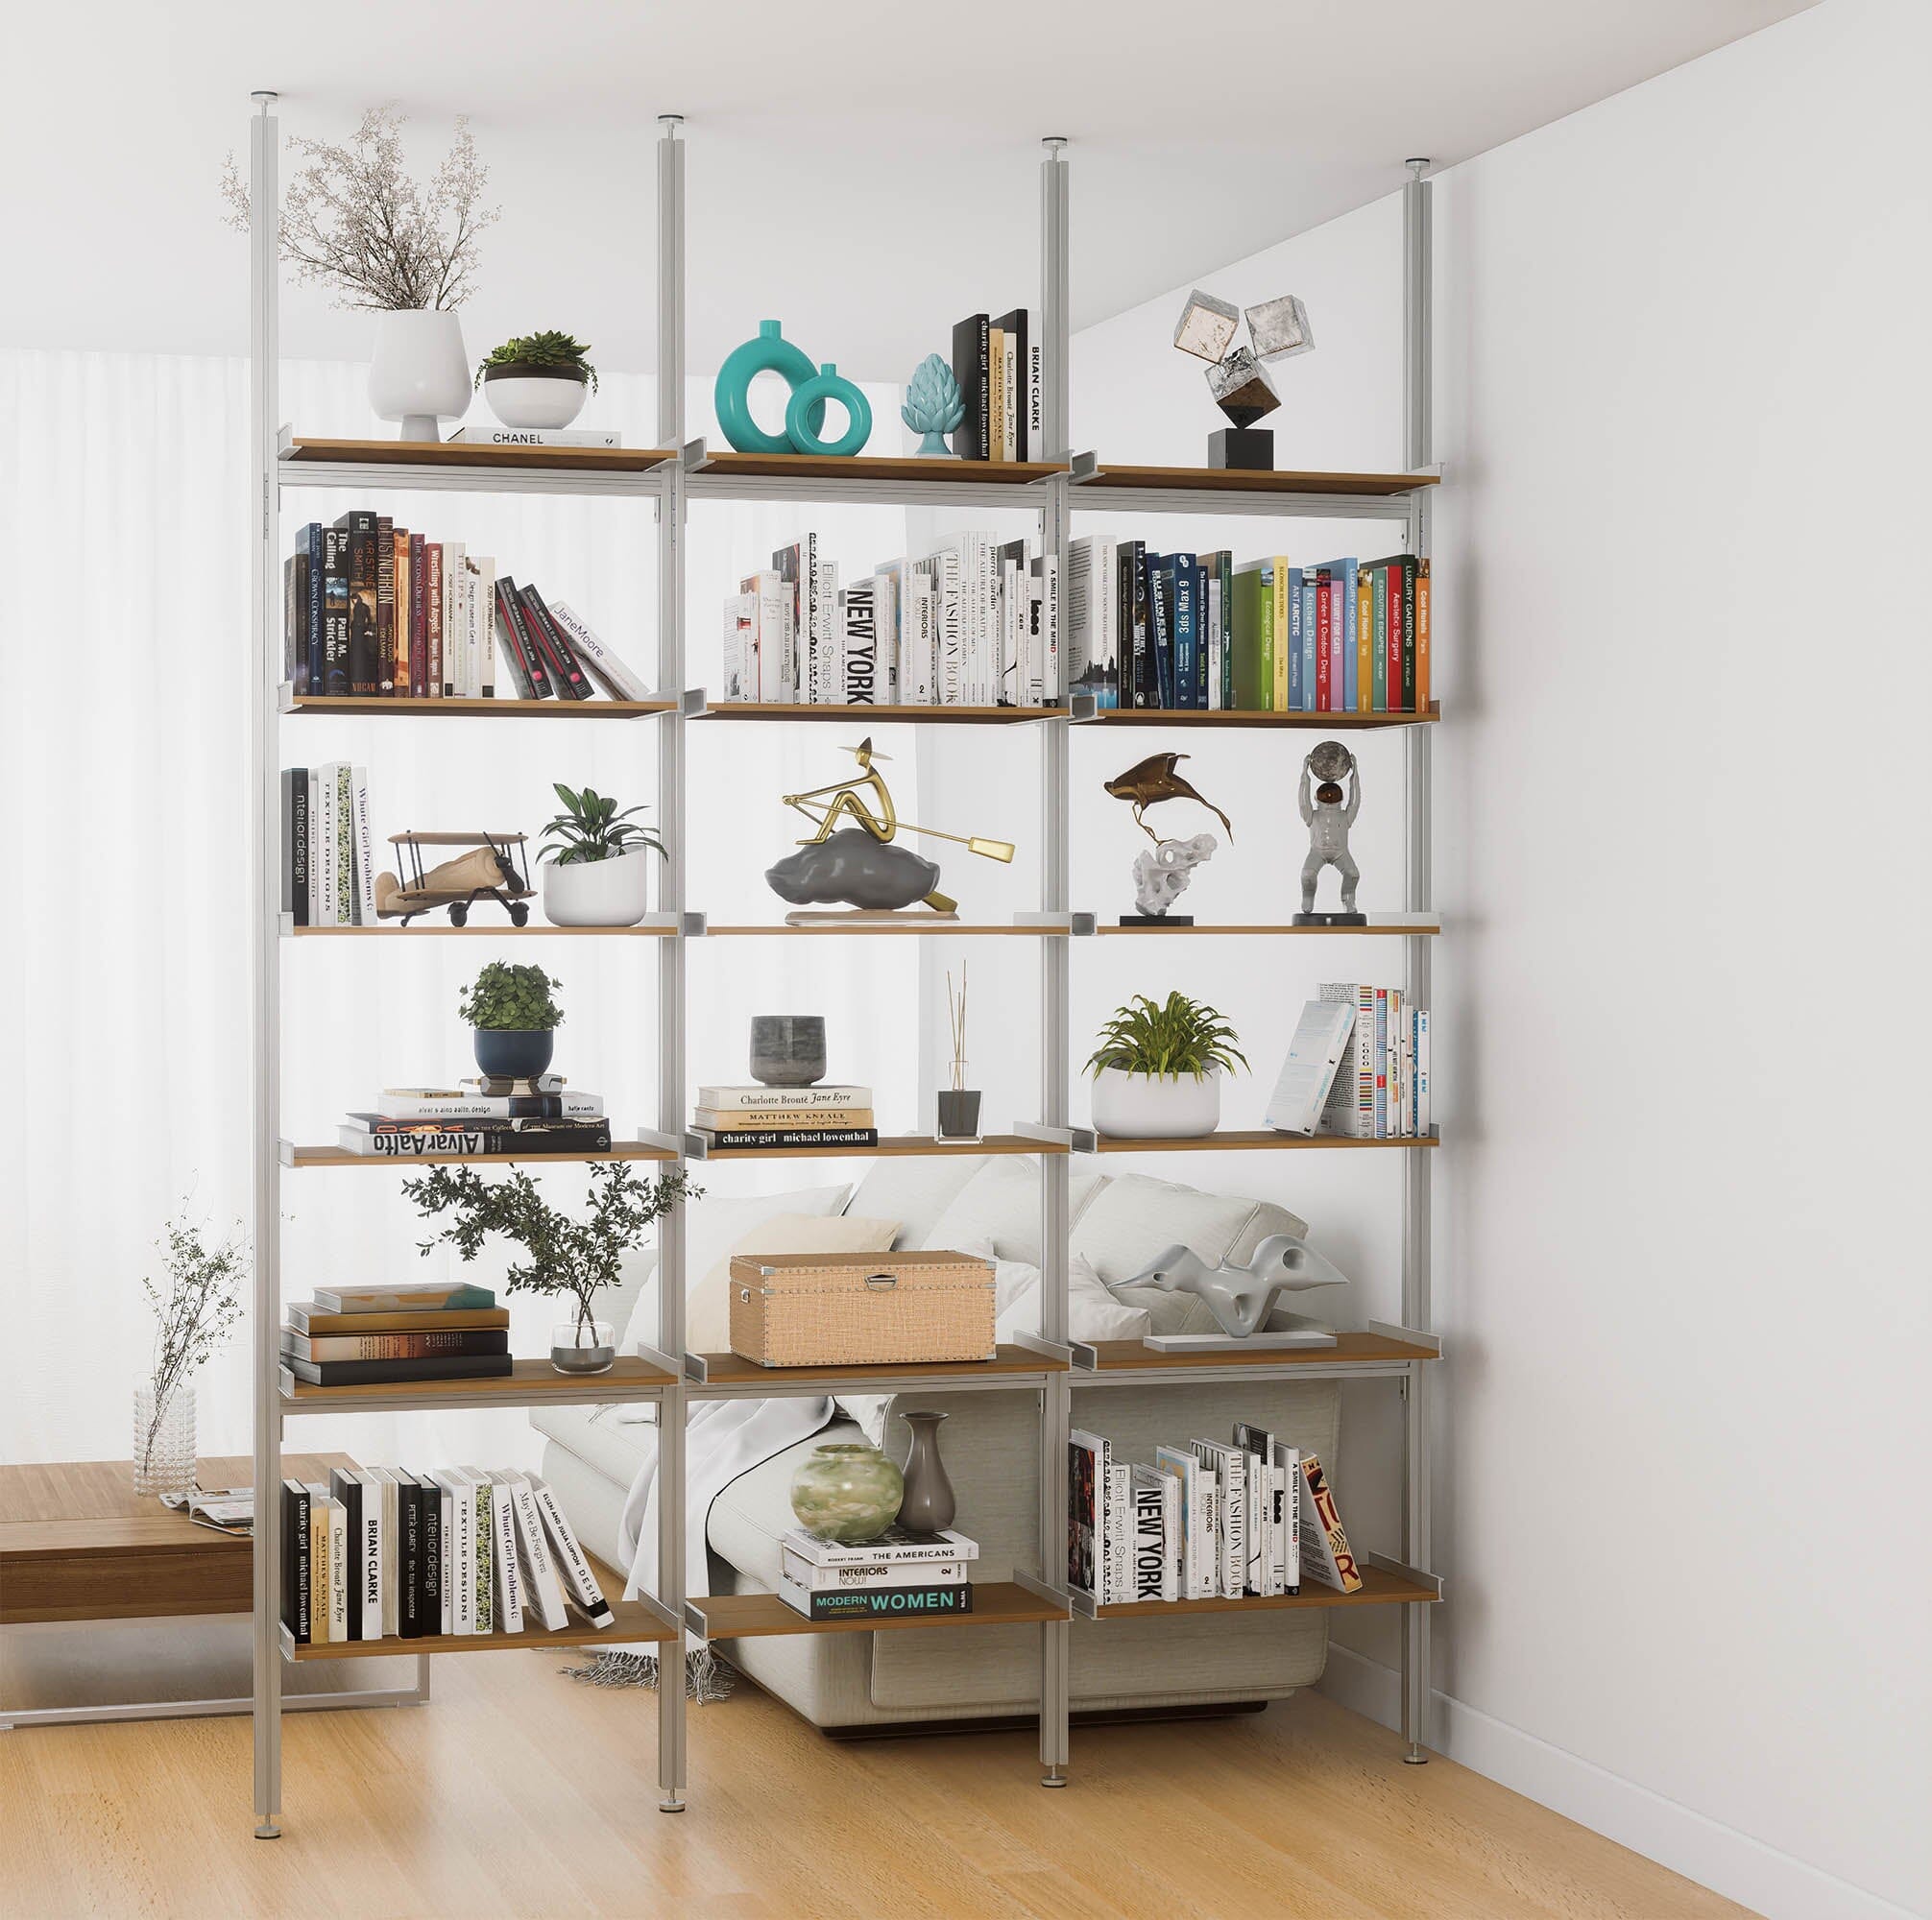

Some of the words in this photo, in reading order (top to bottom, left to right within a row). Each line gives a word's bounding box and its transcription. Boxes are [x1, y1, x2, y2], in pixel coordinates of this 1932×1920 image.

[979, 321, 988, 351] charity
[979, 354, 988, 371] girl
[979, 376, 988, 411] michael
[493, 433, 543, 444] CHANEL
[979, 413, 988, 457] lowenthal
[326, 532, 337, 569] Calling
[338, 531, 349, 552] The
[353, 547, 364, 580] SMITH
[365, 540, 374, 589] KRISTINE
[378, 522, 394, 604] GEOSYNCHRON
[428, 550, 440, 588] Wrestling
[945, 554, 958, 587] THE
[310, 568, 320, 599] CROWN
[430, 588, 440, 607] with
[468, 581, 476, 602] Design
[822, 564, 834, 599] Elliott
[468, 603, 476, 629] museum
[847, 590, 874, 639] NEW
[1050, 603, 1056, 612] IN
[1178, 590, 1189, 612] Max
[310, 600, 320, 646] CONSPIRACY
[338, 617, 348, 640] Paul
[428, 607, 440, 634] Angels
[822, 604, 834, 640] Erwitt
[945, 590, 958, 657] FASHION
[1178, 614, 1189, 634] 3ds
[326, 617, 336, 662] Strickler
[338, 643, 348, 658] M.
[468, 630, 476, 646] Gent
[819, 644, 834, 689] Snaps
[847, 645, 874, 705] YORK
[945, 660, 958, 705] BOOK
[919, 684, 925, 694] 2
[363, 852, 374, 900] Problems
[740, 1094, 779, 1105] Charlotte
[781, 1094, 809, 1105] Brontë
[810, 1092, 832, 1104] Jane
[833, 1092, 852, 1103] Eyre
[722, 1134, 757, 1145] charity
[759, 1133, 777, 1143] girl
[784, 1132, 820, 1142] michael
[822, 1131, 869, 1141] lowenthal
[1113, 1469, 1125, 1502] Elliott
[1229, 1453, 1243, 1486] THE
[298, 1500, 308, 1531] charity
[408, 1504, 417, 1527] PETER
[519, 1492, 531, 1511] May
[1137, 1490, 1162, 1537] NEW
[1292, 1496, 1298, 1504] IN
[525, 1511, 535, 1527] We
[529, 1526, 538, 1538] Be
[1113, 1506, 1125, 1541] Erwitt
[1229, 1488, 1243, 1550] FASHION
[298, 1533, 308, 1549] girl
[368, 1520, 377, 1556] BRIAN
[504, 1540, 515, 1561] Girl
[550, 1511, 562, 1525] AND
[557, 1525, 569, 1542] JULIA
[565, 1541, 581, 1566] LUPTON
[895, 1549, 955, 1559] AMERICANS
[408, 1560, 417, 1572] the
[531, 1538, 548, 1573] Forgiven
[838, 1567, 888, 1577] INTERIORS
[940, 1567, 952, 1575] 2
[1113, 1546, 1125, 1588] Snaps
[1137, 1543, 1162, 1599] YORK
[298, 1555, 308, 1591] michael
[368, 1560, 377, 1604] CLARKE
[507, 1563, 519, 1610] Problems
[838, 1576, 866, 1586] NOW!
[1204, 1576, 1210, 1585] 2
[1229, 1555, 1243, 1596] BOOK
[298, 1592, 308, 1635] lowenthal
[334, 1588, 344, 1606] Jane
[408, 1586, 417, 1620] inspector
[816, 1596, 868, 1607] MODERN
[871, 1592, 954, 1611] WOMEN
